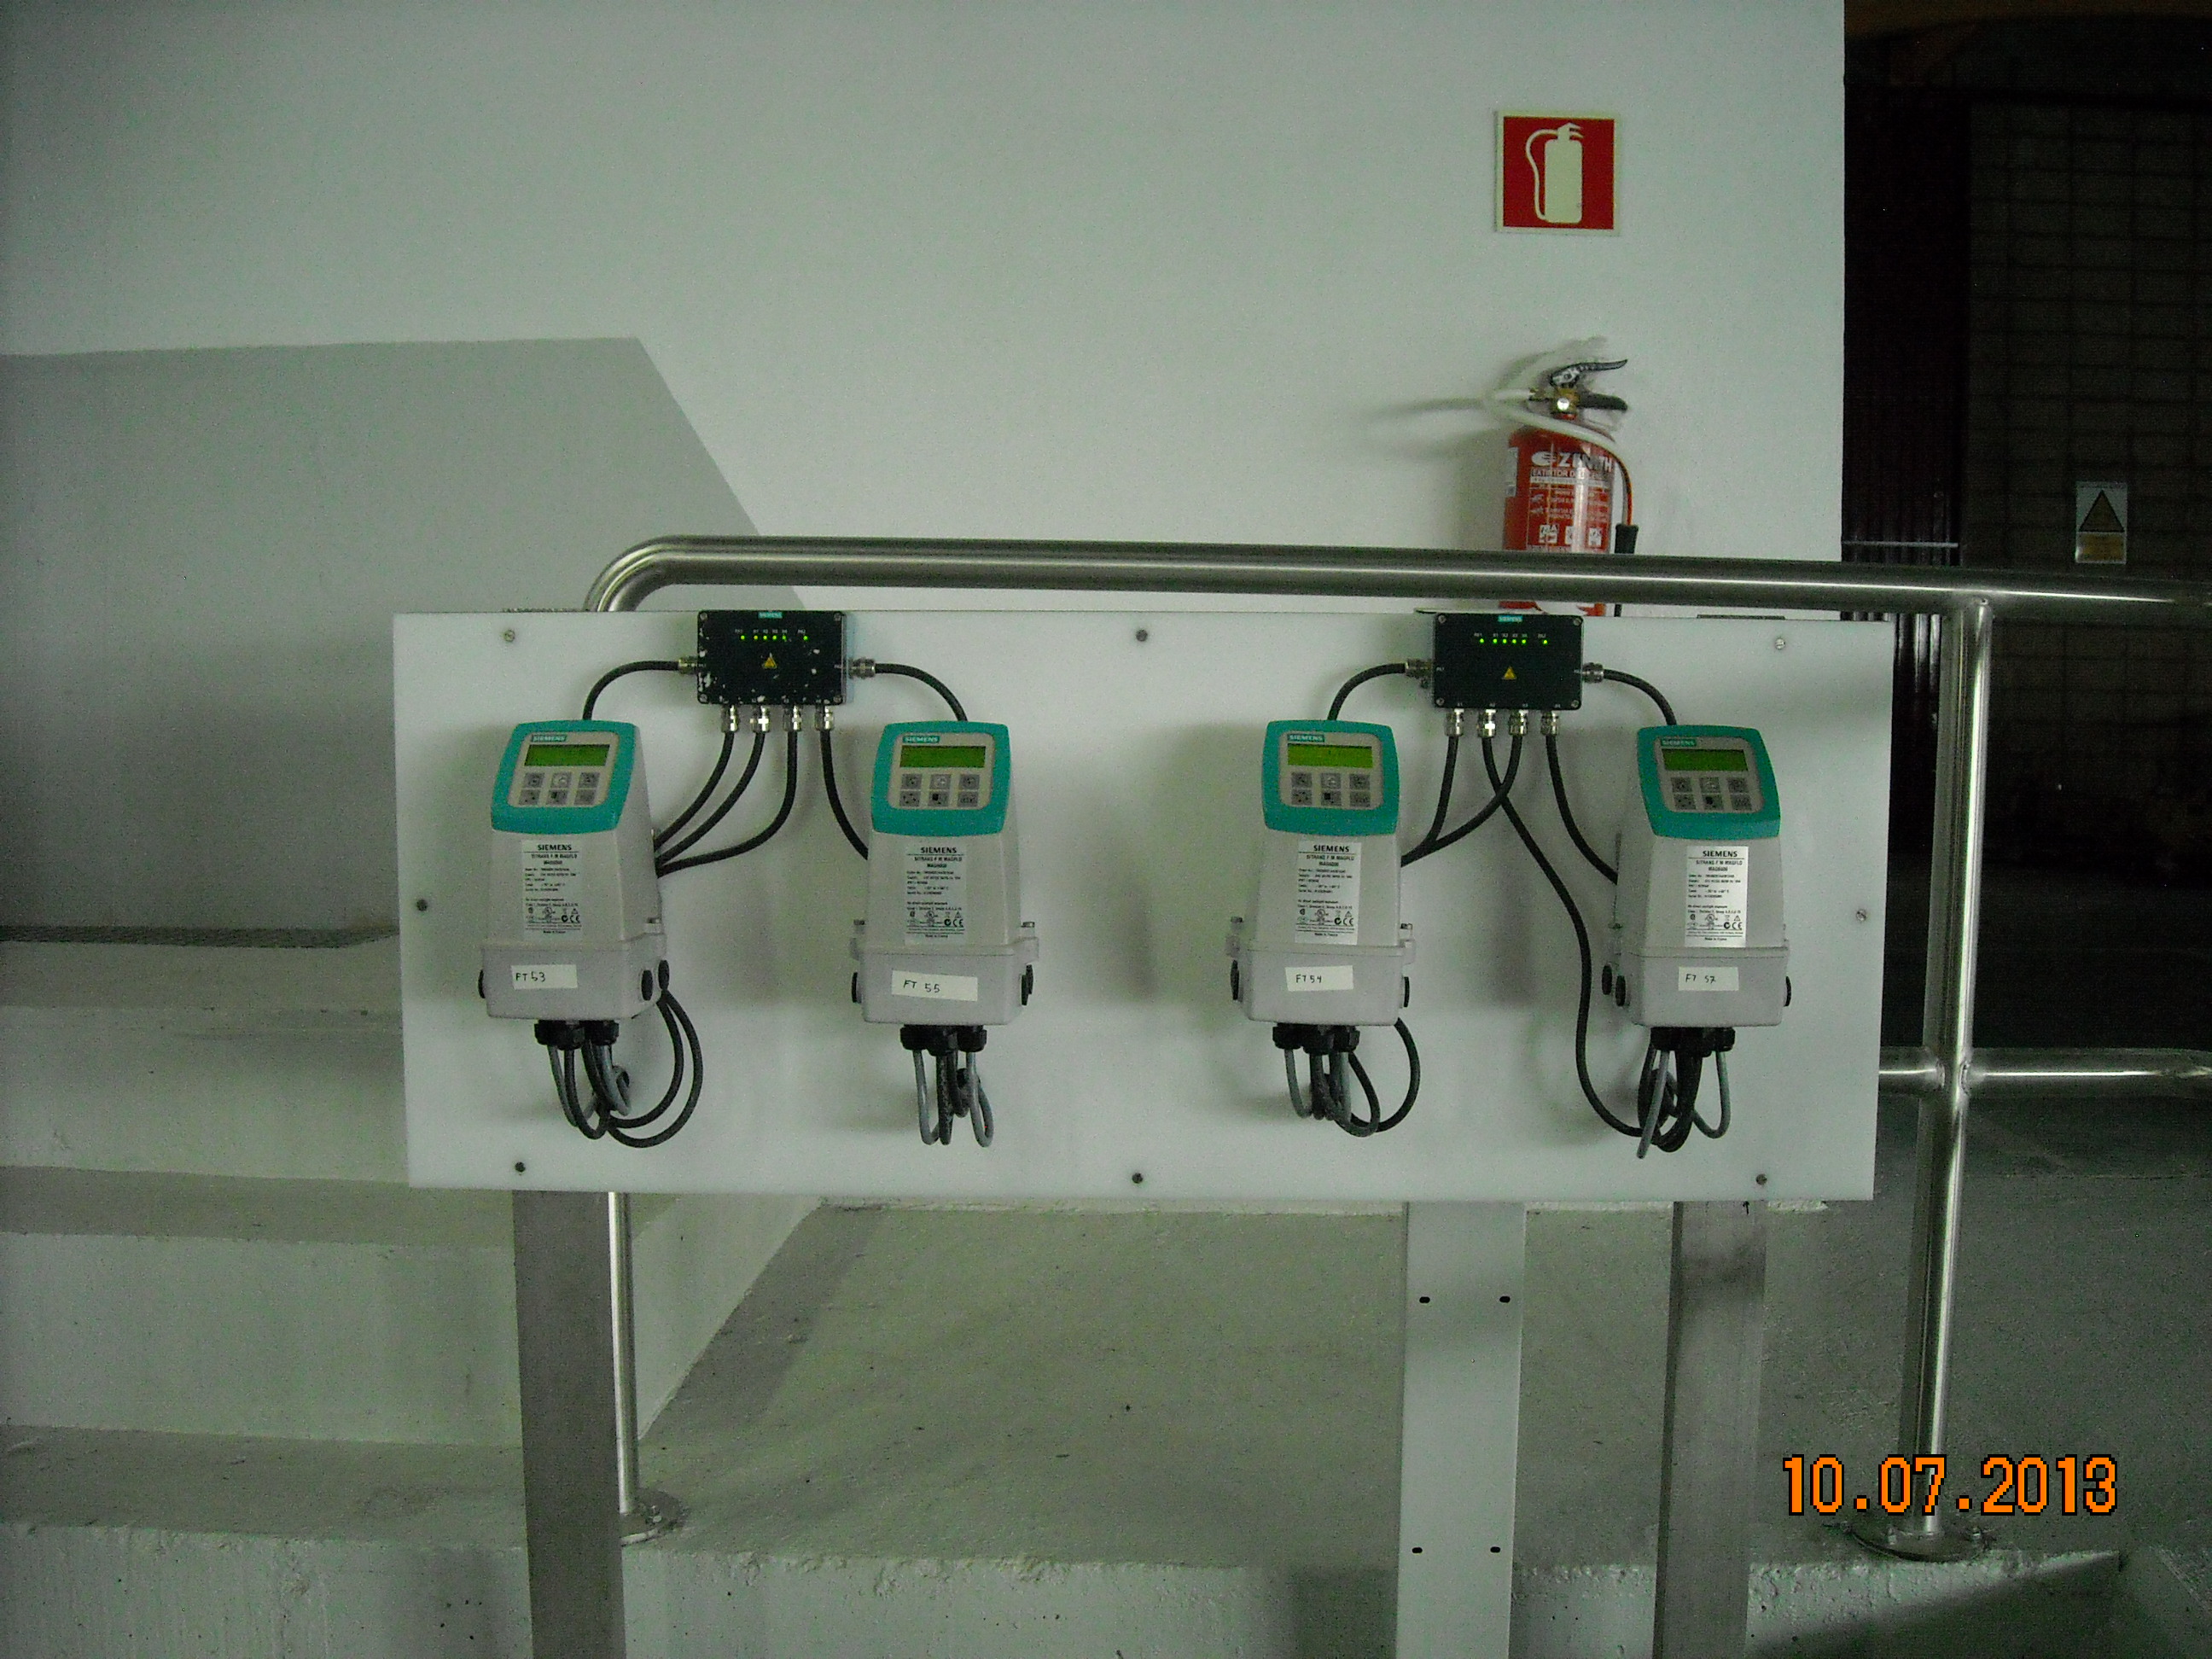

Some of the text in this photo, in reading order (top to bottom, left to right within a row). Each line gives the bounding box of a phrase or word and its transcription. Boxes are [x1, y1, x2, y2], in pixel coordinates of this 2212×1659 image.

[1313, 844, 1349, 853] SIEMENS
[515, 970, 546, 982] FT 53
[1295, 974, 1322, 983] FT 54
[1685, 973, 1697, 983] FT
[903, 979, 940, 993] FT 55
